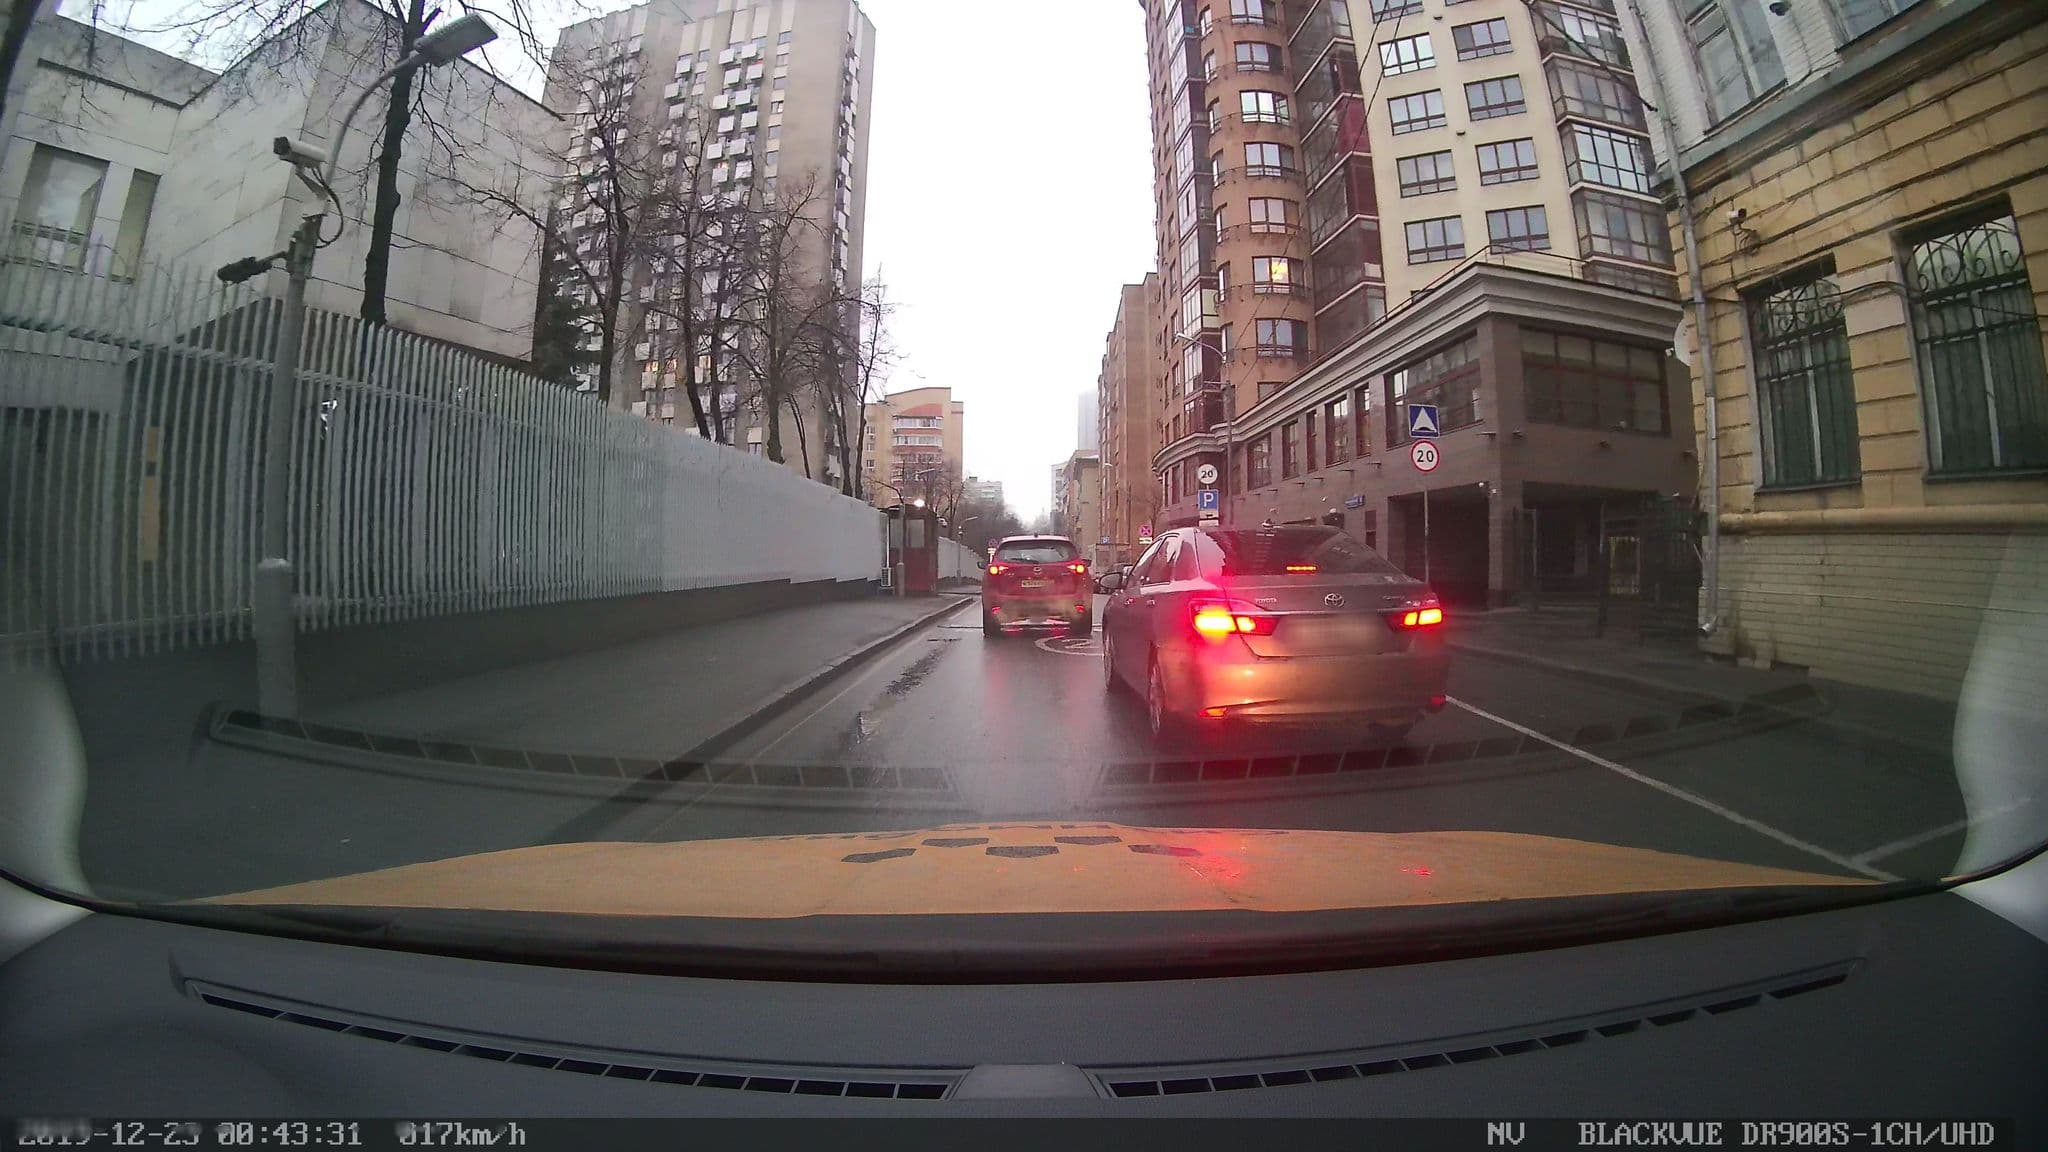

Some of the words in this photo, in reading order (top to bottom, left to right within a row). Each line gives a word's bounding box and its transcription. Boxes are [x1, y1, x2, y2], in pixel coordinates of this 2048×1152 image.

[1417, 450, 1434, 463] 20
[1201, 470, 1213, 479] 20
[1203, 492, 1214, 507] P
